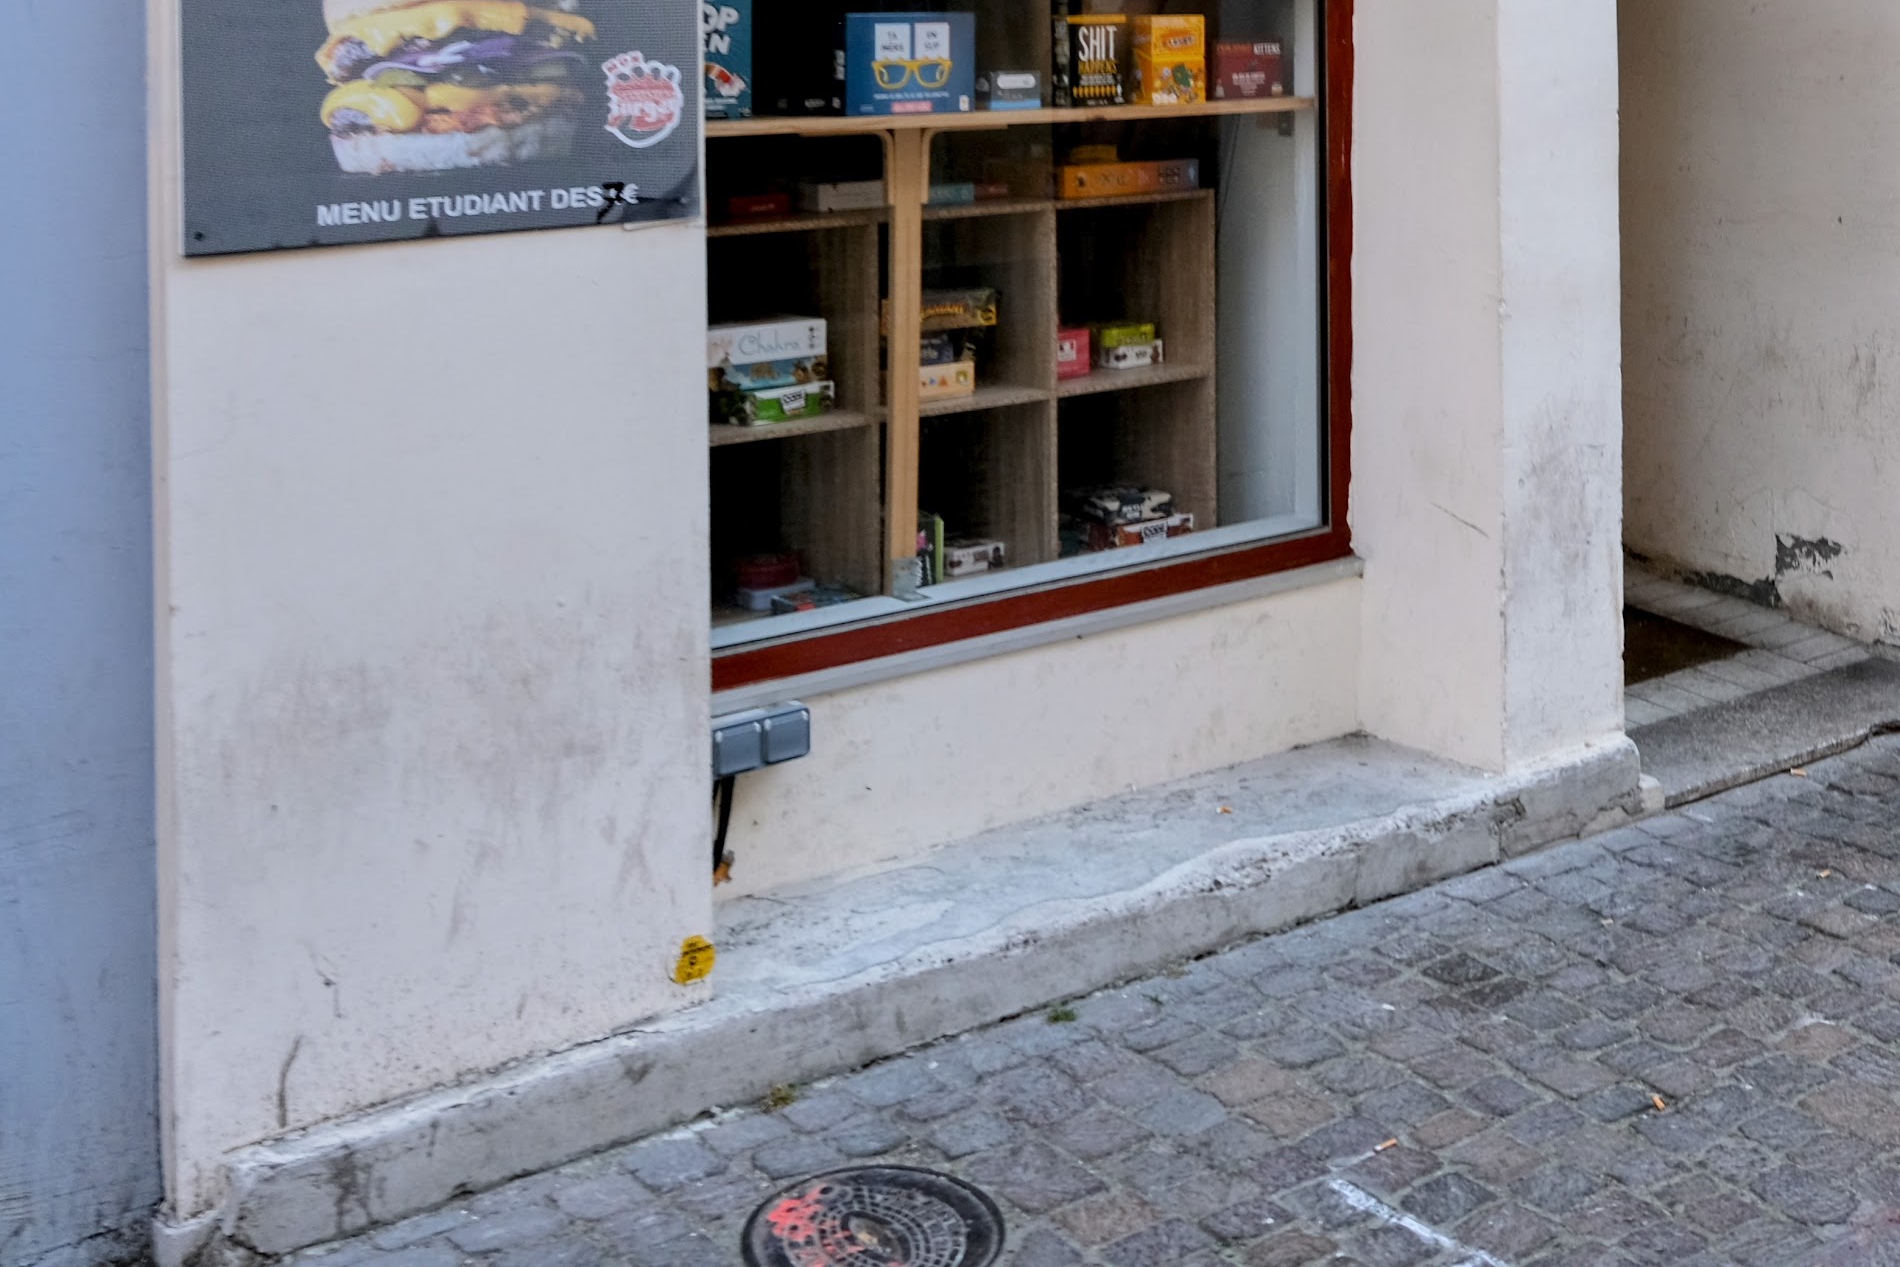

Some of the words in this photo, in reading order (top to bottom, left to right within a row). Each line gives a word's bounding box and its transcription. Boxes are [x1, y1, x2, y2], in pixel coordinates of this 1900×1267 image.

[1078, 25, 1117, 62] SHIT
[1253, 42, 1282, 55] KITTENS
[316, 199, 399, 226] MENU
[408, 189, 546, 220] ETUDIANT
[551, 185, 602, 211] DES
[737, 329, 803, 355] Chakra
